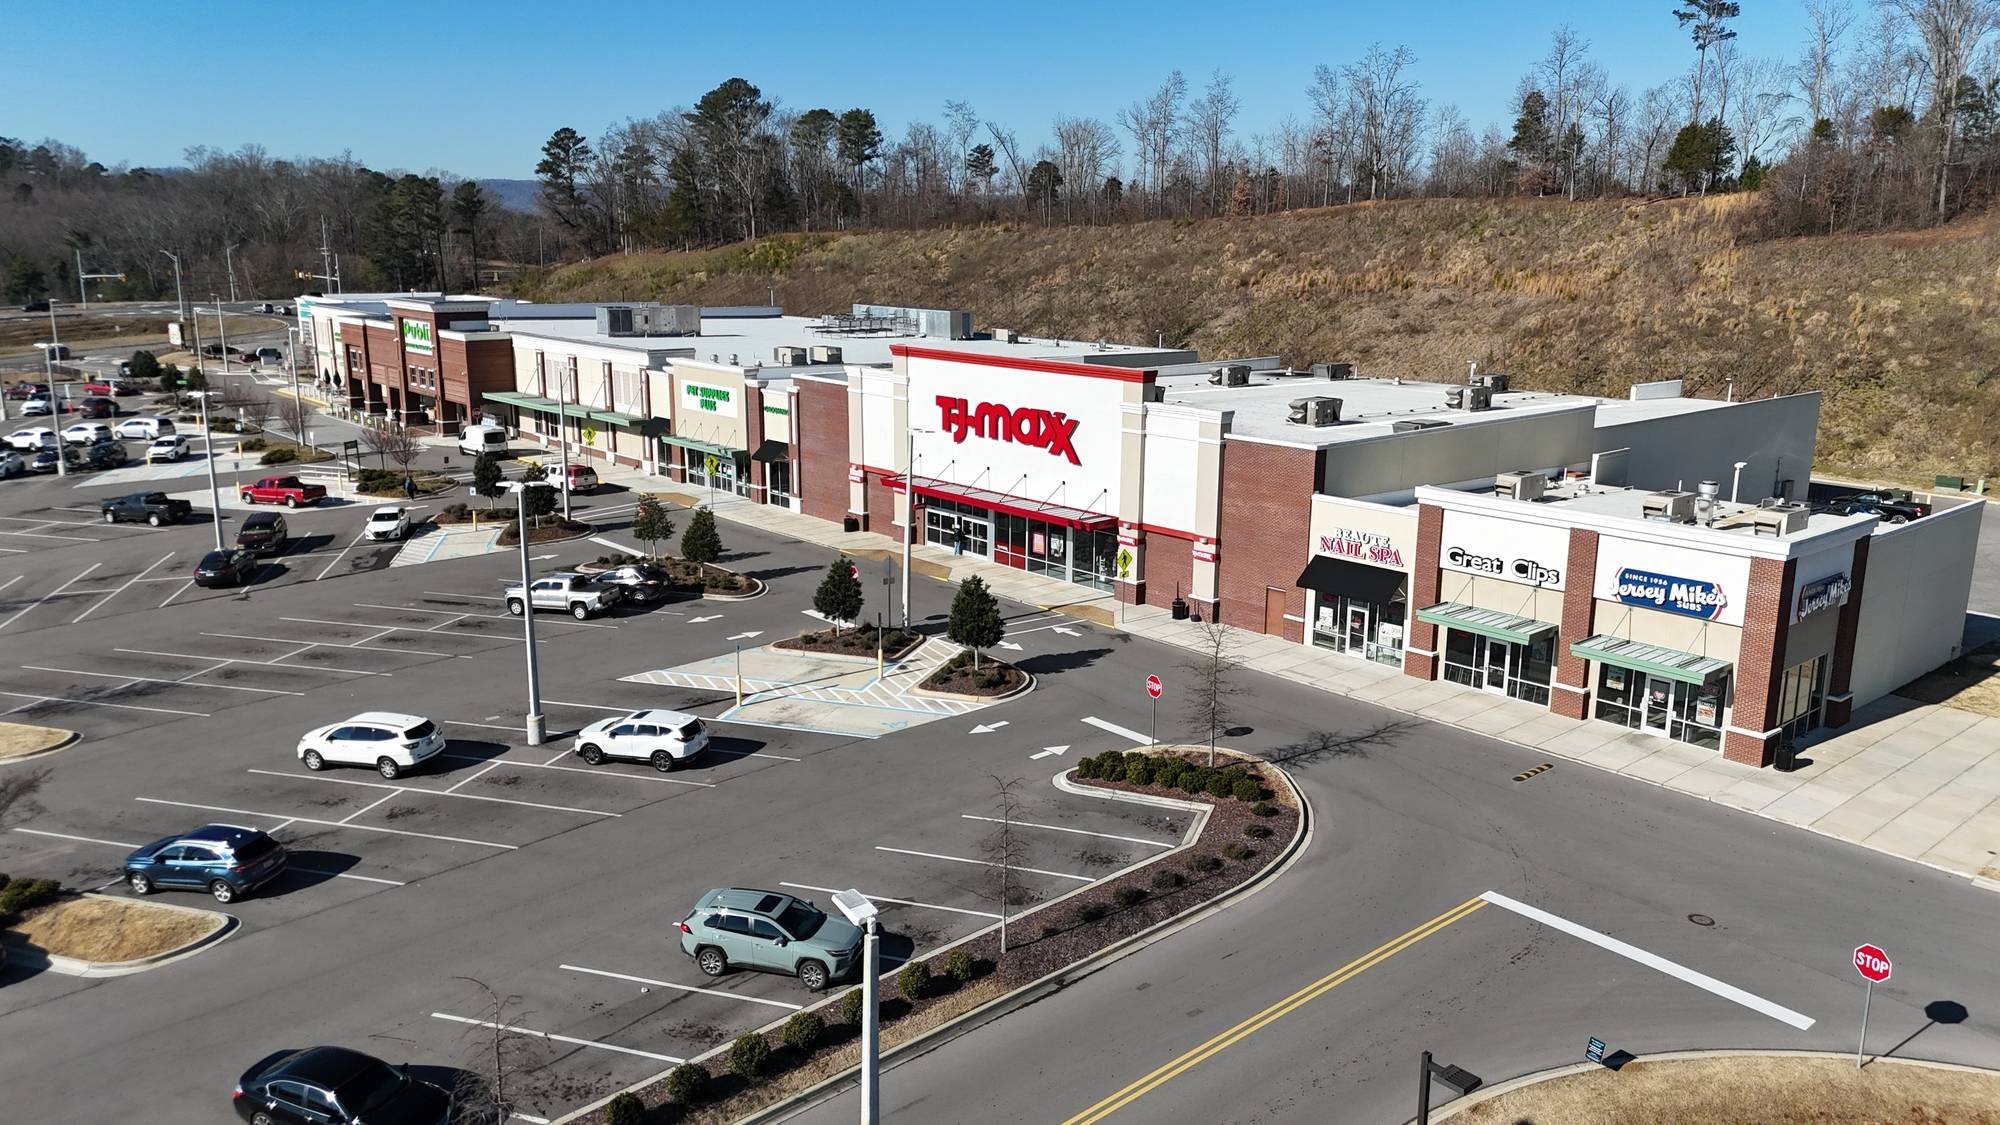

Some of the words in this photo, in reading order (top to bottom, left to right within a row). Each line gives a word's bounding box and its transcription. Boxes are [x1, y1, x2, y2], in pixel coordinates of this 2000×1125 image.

[404, 321, 429, 340] Publi
[687, 385, 698, 396] PET
[700, 387, 730, 402] SUPPLIES
[700, 398, 717, 411] PLUS
[1334, 528, 1390, 548] BEAUTE
[1320, 535, 1366, 560] NAIL
[1369, 545, 1404, 567] SPA
[1447, 547, 1504, 574] Great
[1512, 559, 1560, 587] Clips
[1625, 573, 1648, 583] SINCE
[1609, 577, 1667, 605] Jersey
[1669, 583, 1728, 608] Mike's
[1676, 600, 1702, 612] SUBS
[1147, 681, 1161, 691] STOP
[1856, 951, 1889, 974] STOP
